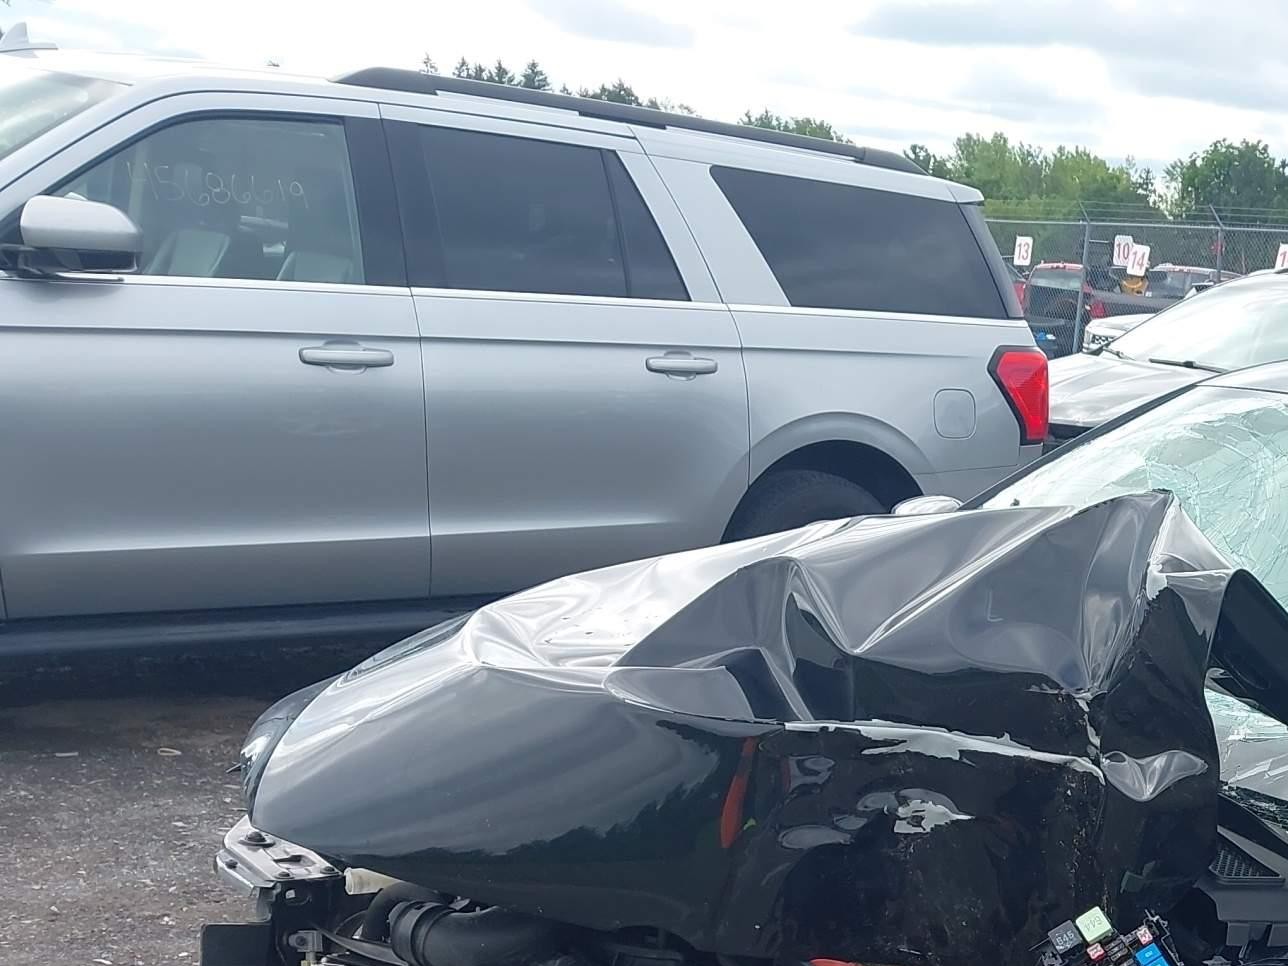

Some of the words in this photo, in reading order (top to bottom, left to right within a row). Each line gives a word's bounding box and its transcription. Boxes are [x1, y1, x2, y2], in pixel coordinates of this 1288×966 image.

[127, 161, 309, 208] 45686619
[1017, 242, 1030, 261] 13
[1116, 242, 1130, 260] 10
[1132, 250, 1146, 270] 14
